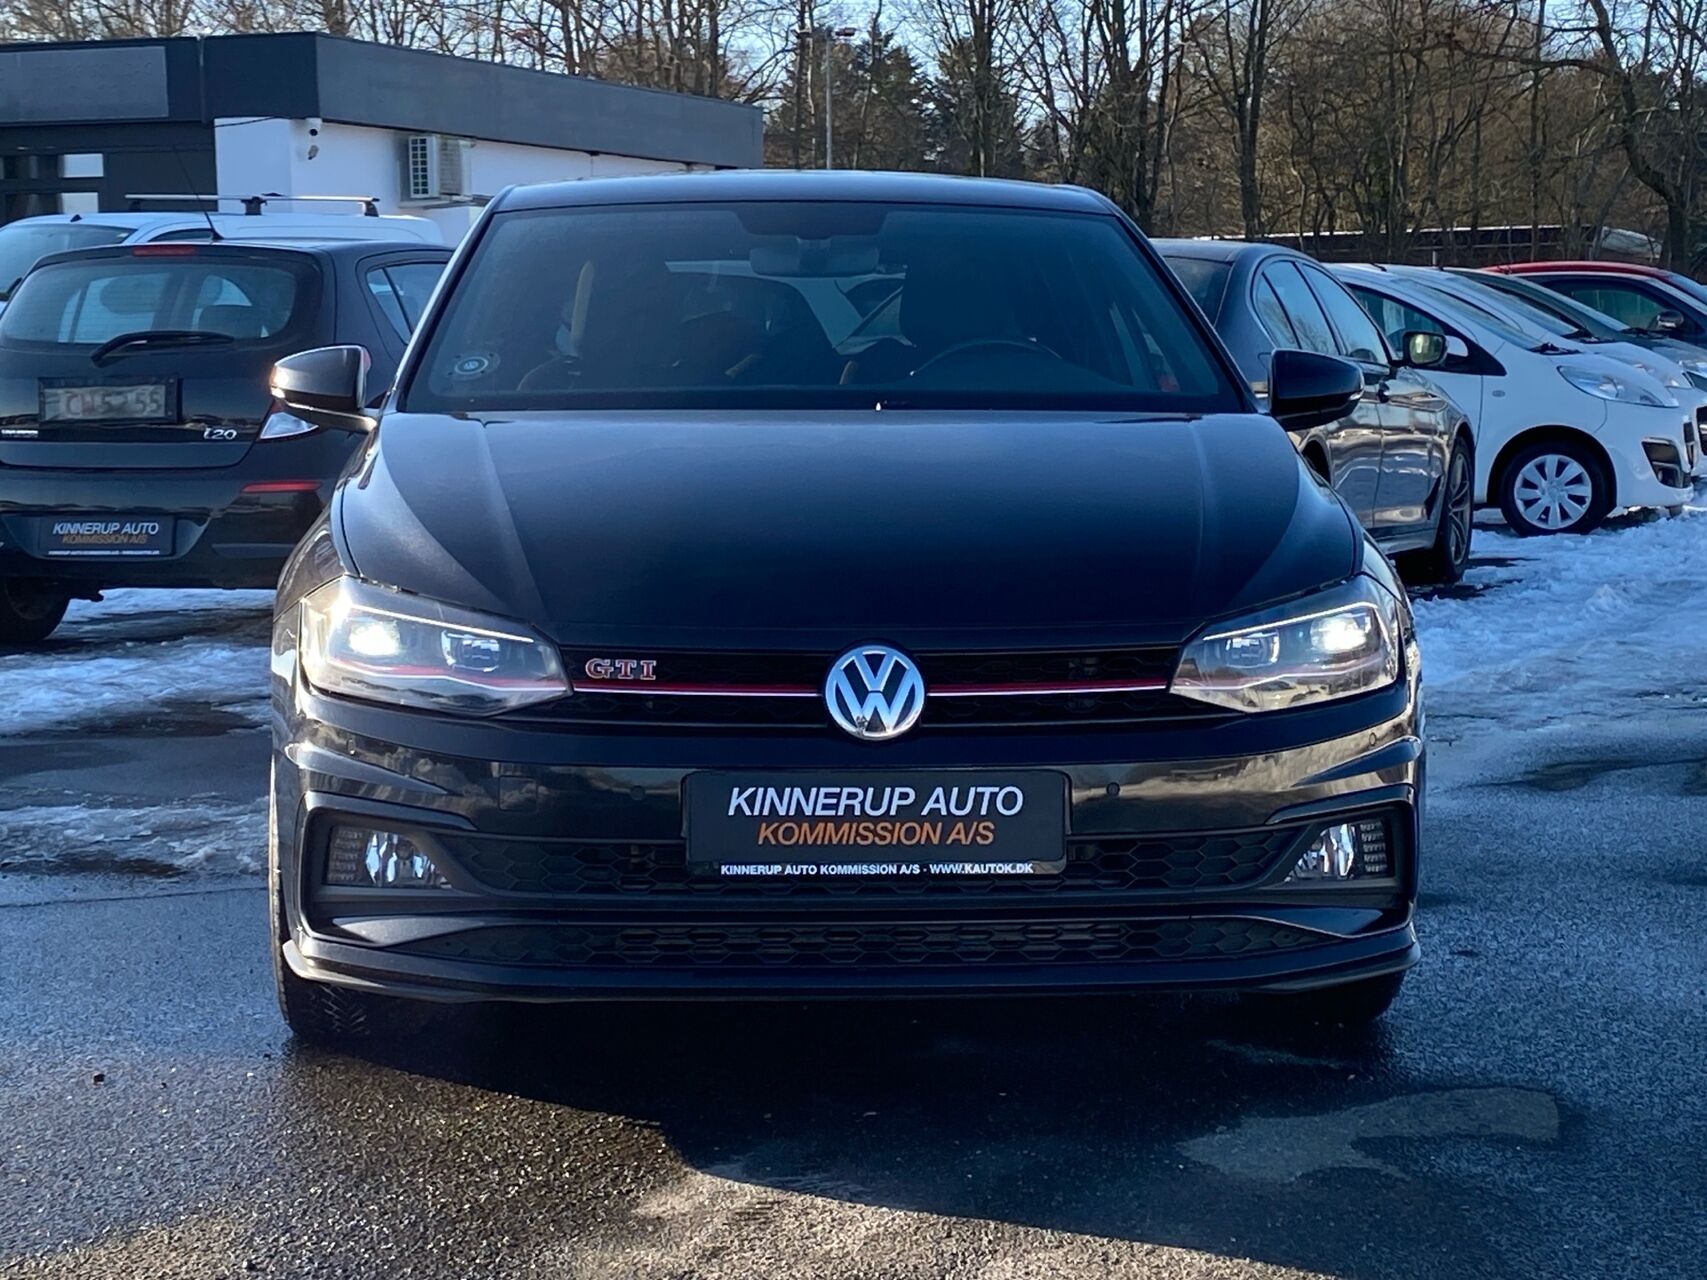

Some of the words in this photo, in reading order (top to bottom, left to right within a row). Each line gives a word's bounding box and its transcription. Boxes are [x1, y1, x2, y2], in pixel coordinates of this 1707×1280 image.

[52, 522, 120, 534] KINNERUP
[121, 522, 159, 534] AUTO
[62, 534, 127, 544] KOMMISSION
[585, 658, 657, 681] GTI
[727, 786, 915, 816] KINNERUP
[921, 786, 1024, 816] AUTO
[757, 821, 943, 846] KOMMISSION
[945, 821, 995, 845] A/S
[720, 864, 783, 876] KINNERUP
[784, 864, 817, 875] AUTO
[819, 864, 897, 875] KOMMISSION
[899, 864, 921, 875] A/S
[929, 863, 1034, 875] WWW.KAUTOK.DK
